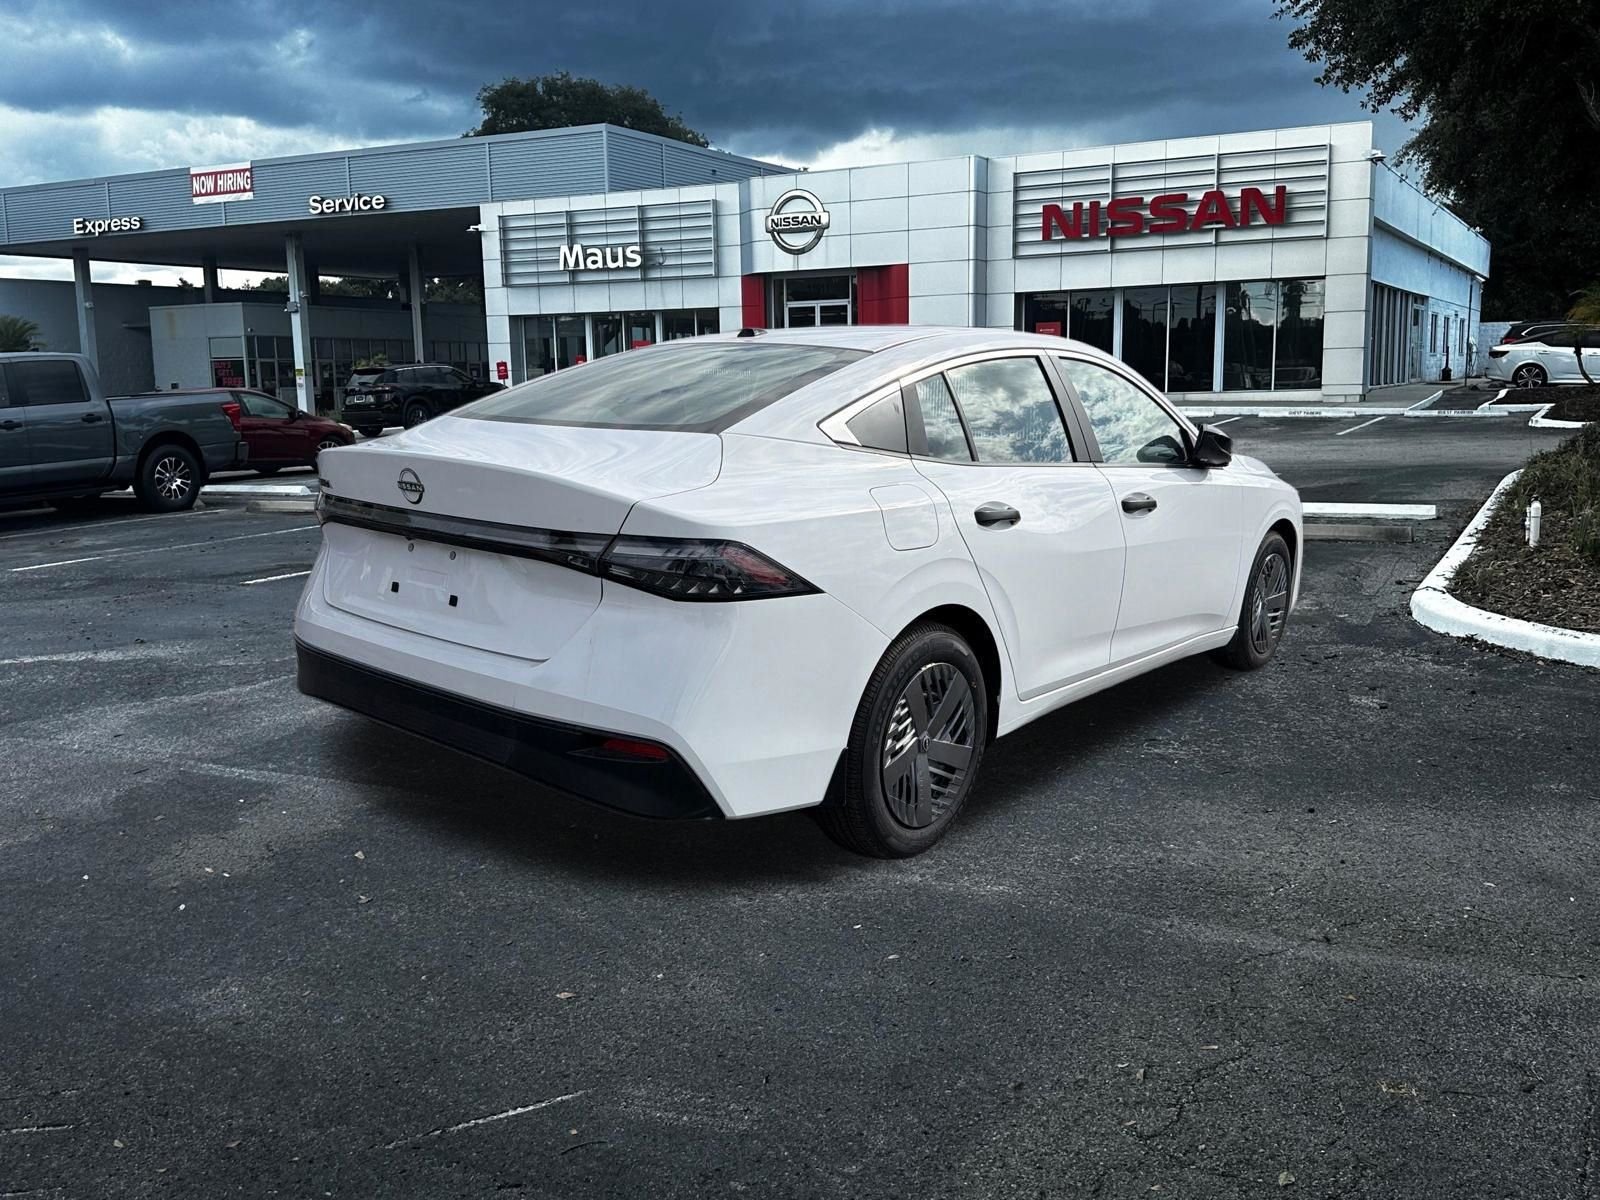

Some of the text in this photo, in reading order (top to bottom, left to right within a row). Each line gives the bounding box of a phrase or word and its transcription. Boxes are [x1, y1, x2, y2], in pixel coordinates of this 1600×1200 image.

[192, 171, 251, 195] NOW HIRING
[309, 193, 385, 214] Service
[1042, 185, 1287, 241] NISSAN
[73, 216, 141, 236] Express
[770, 215, 822, 228] NISSAN
[559, 244, 642, 271] Maus
[223, 376, 244, 386] FREE
